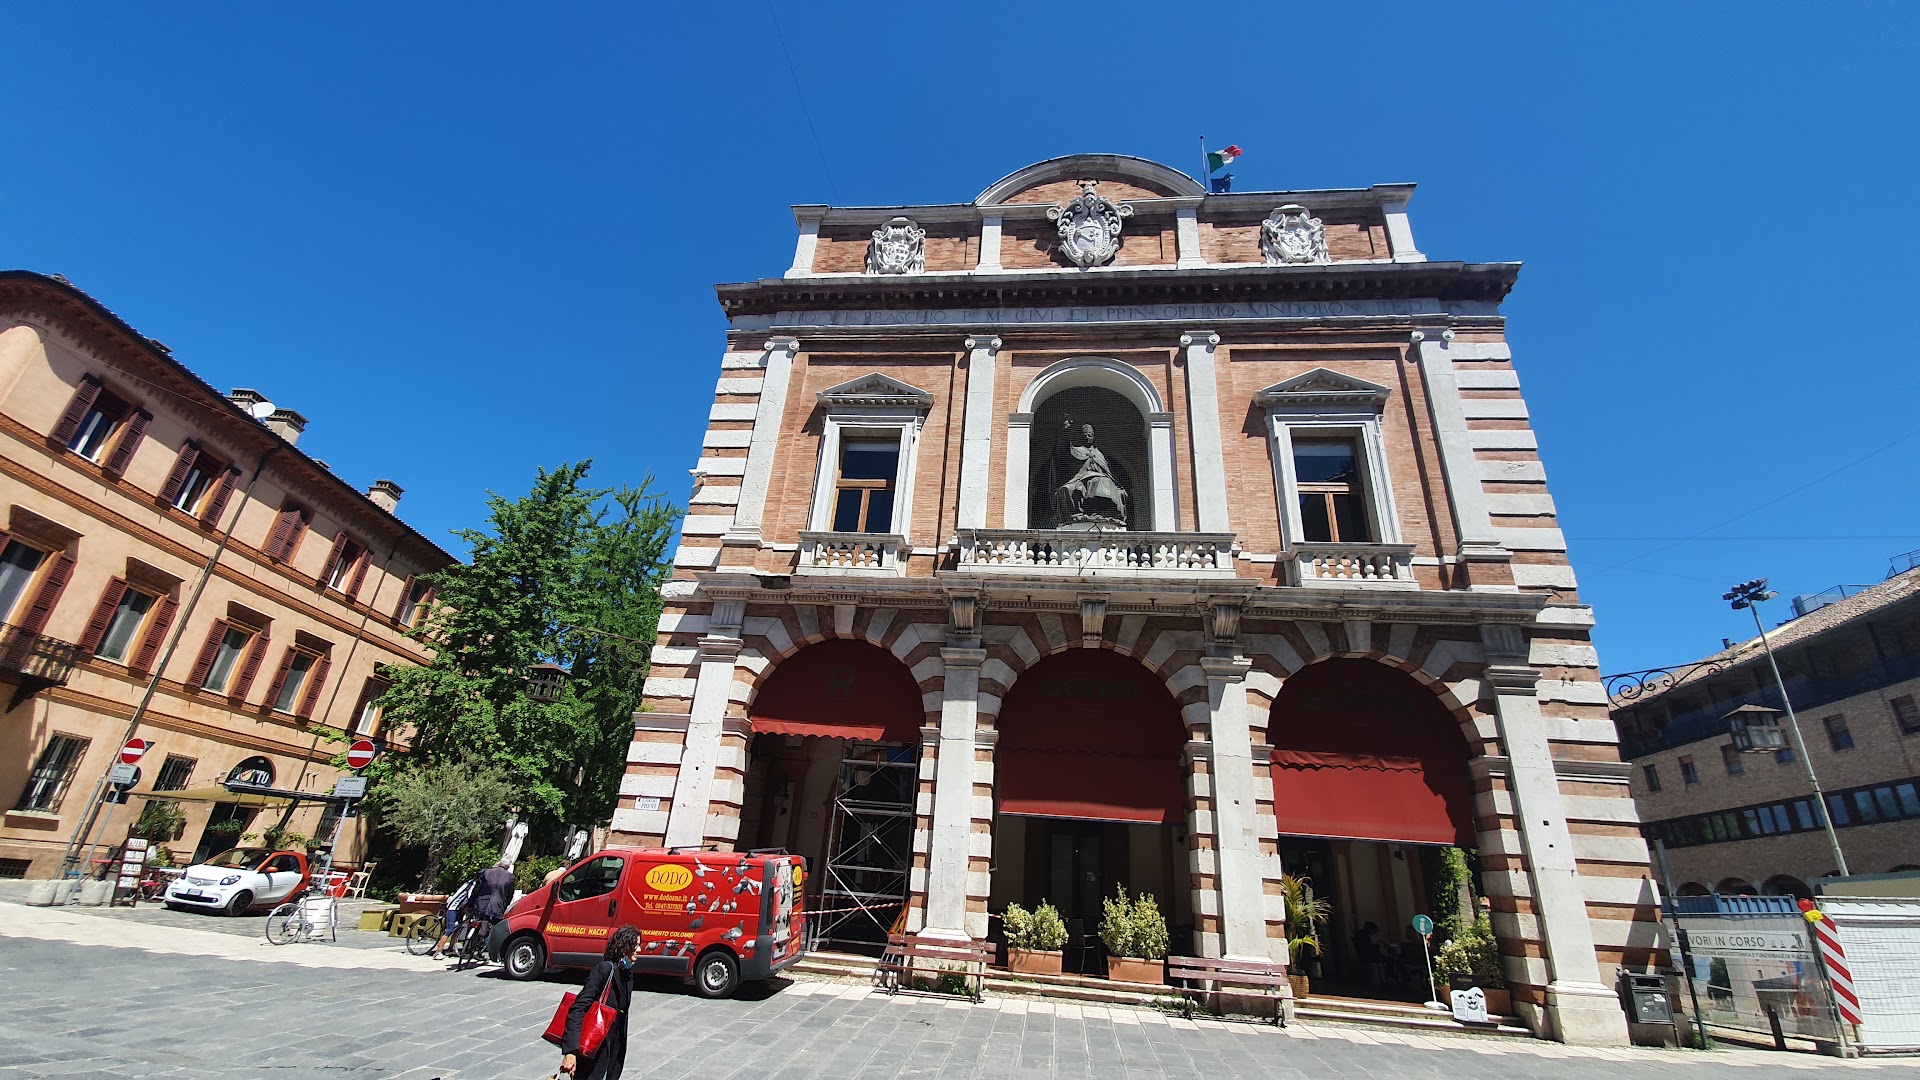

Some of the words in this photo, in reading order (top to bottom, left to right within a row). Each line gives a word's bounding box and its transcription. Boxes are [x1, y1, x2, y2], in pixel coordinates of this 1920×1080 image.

[651, 870, 689, 885] DODO
[1688, 936, 1712, 946] VORI
[1714, 936, 1726, 946] IN
[1728, 936, 1766, 948] CORSO
